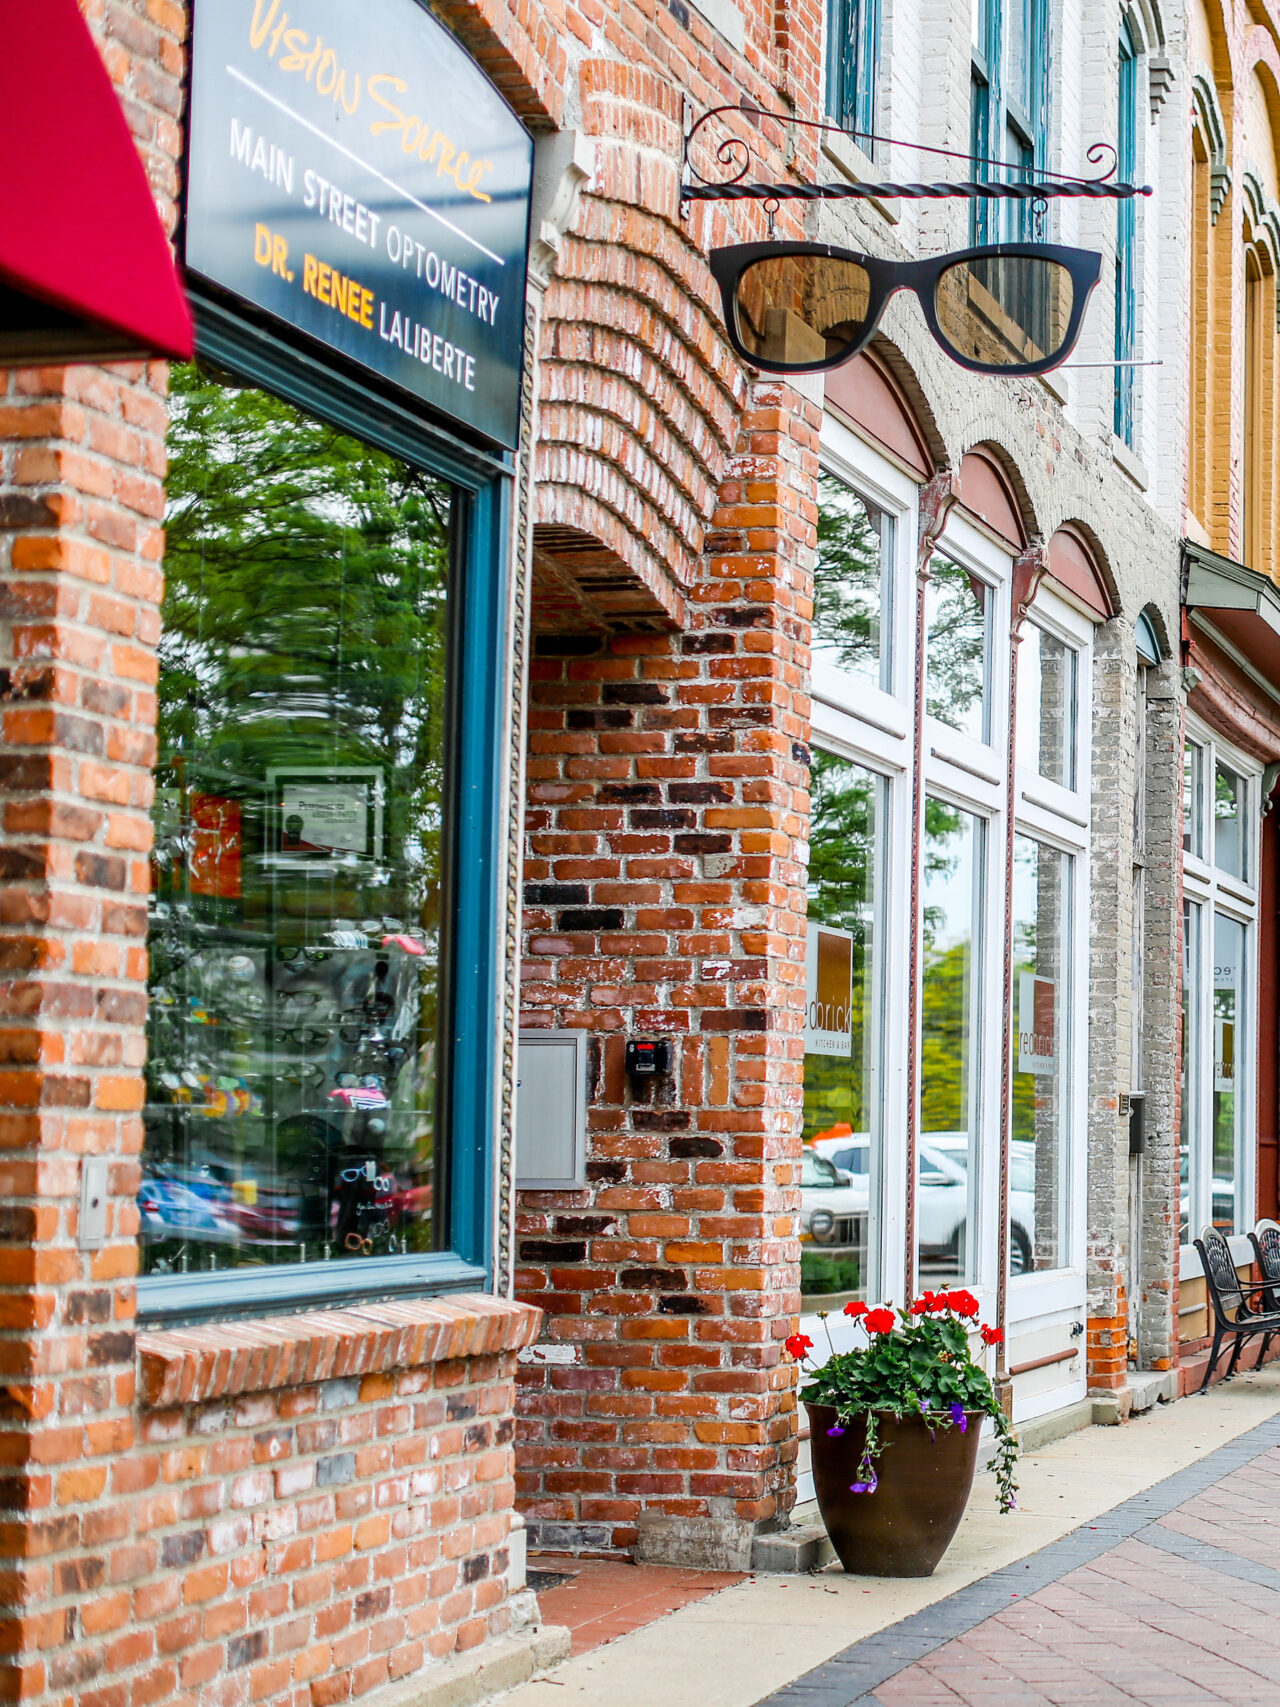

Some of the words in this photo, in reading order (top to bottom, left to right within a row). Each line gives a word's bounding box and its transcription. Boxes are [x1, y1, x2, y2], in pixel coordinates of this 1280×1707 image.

[230, 117, 293, 195] MAIN
[303, 168, 381, 248] STREET
[386, 225, 500, 326] OPTOMETRY
[254, 222, 295, 283] DR.
[303, 252, 375, 331] RENEE
[379, 301, 476, 392] LALIBERTE
